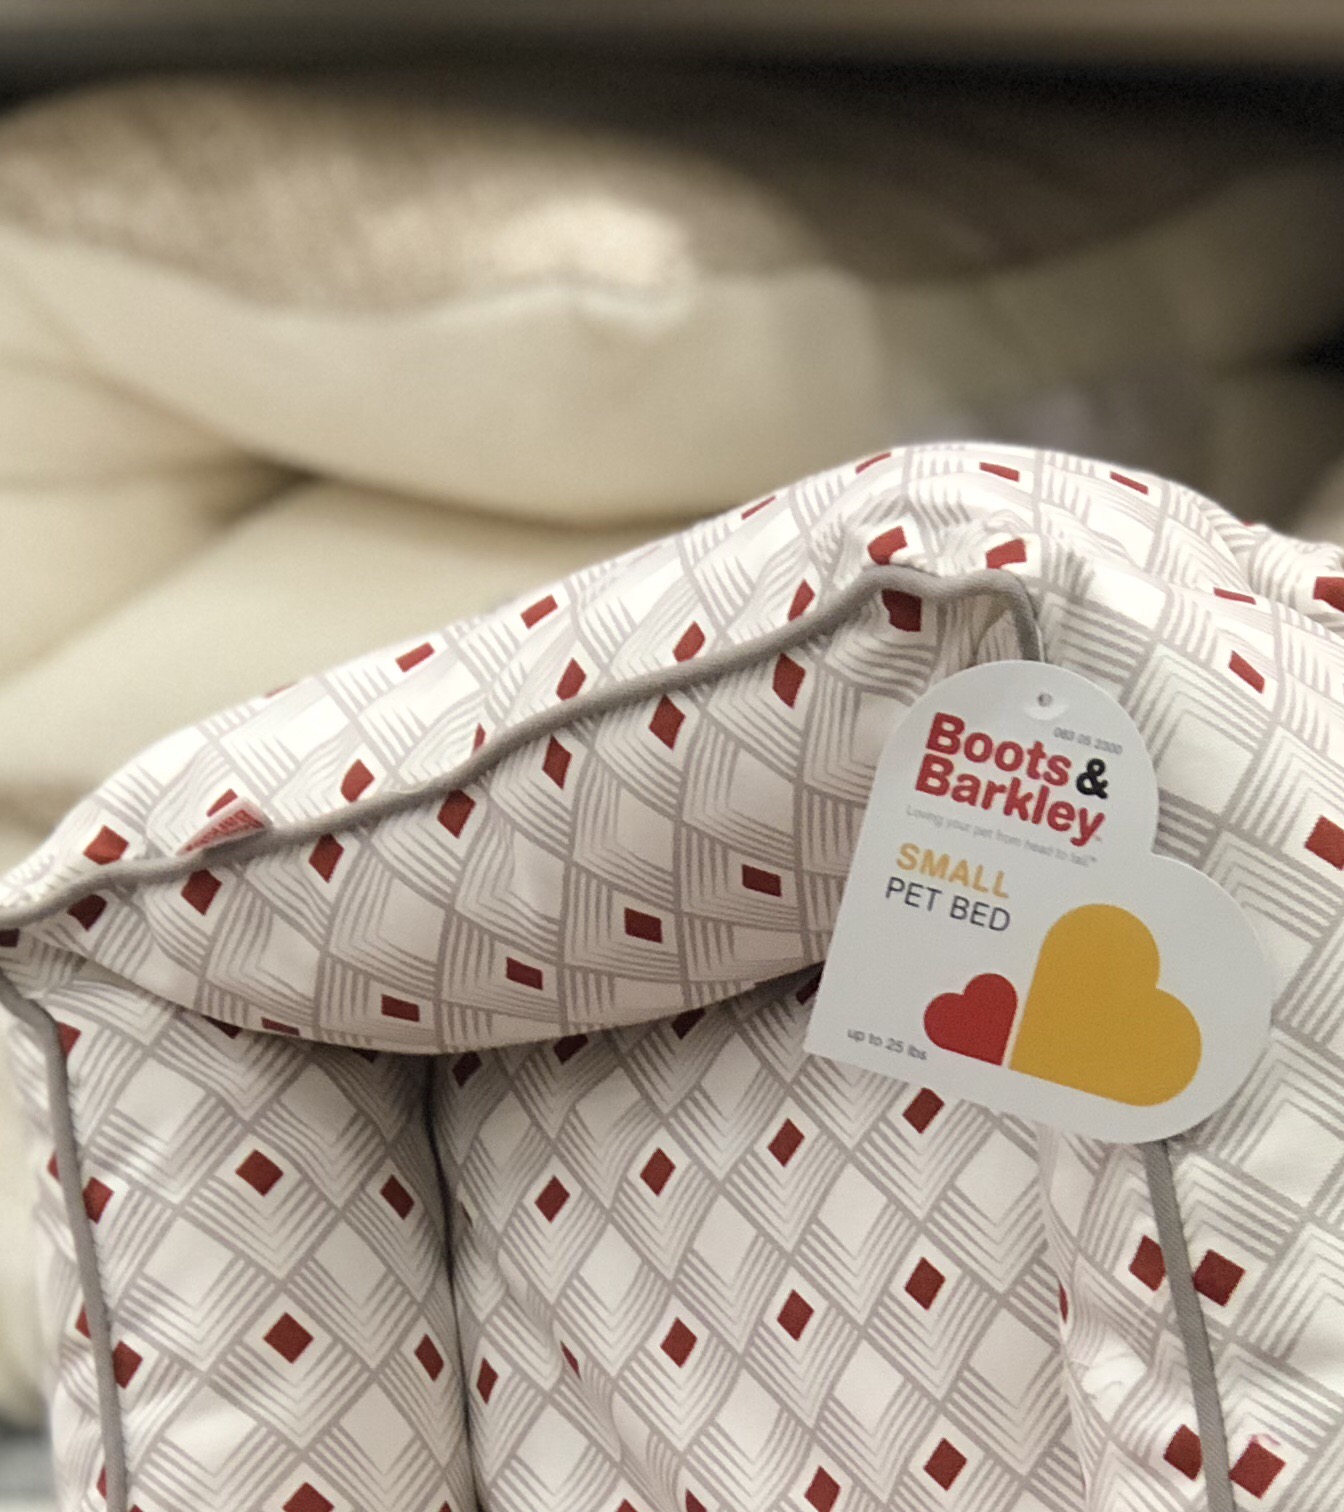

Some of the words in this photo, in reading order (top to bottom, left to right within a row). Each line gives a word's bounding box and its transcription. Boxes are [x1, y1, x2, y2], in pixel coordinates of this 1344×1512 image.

[926, 712, 1072, 786] Boots
[1076, 758, 1109, 799] &
[915, 753, 1105, 847] Barkley
[896, 843, 1009, 899] SMALL
[885, 877, 943, 912] PET
[949, 895, 1011, 932] BED
[847, 1029, 865, 1043] up
[868, 1033, 883, 1046] to
[885, 1038, 904, 1053] 25
[908, 1044, 927, 1060] lbs
